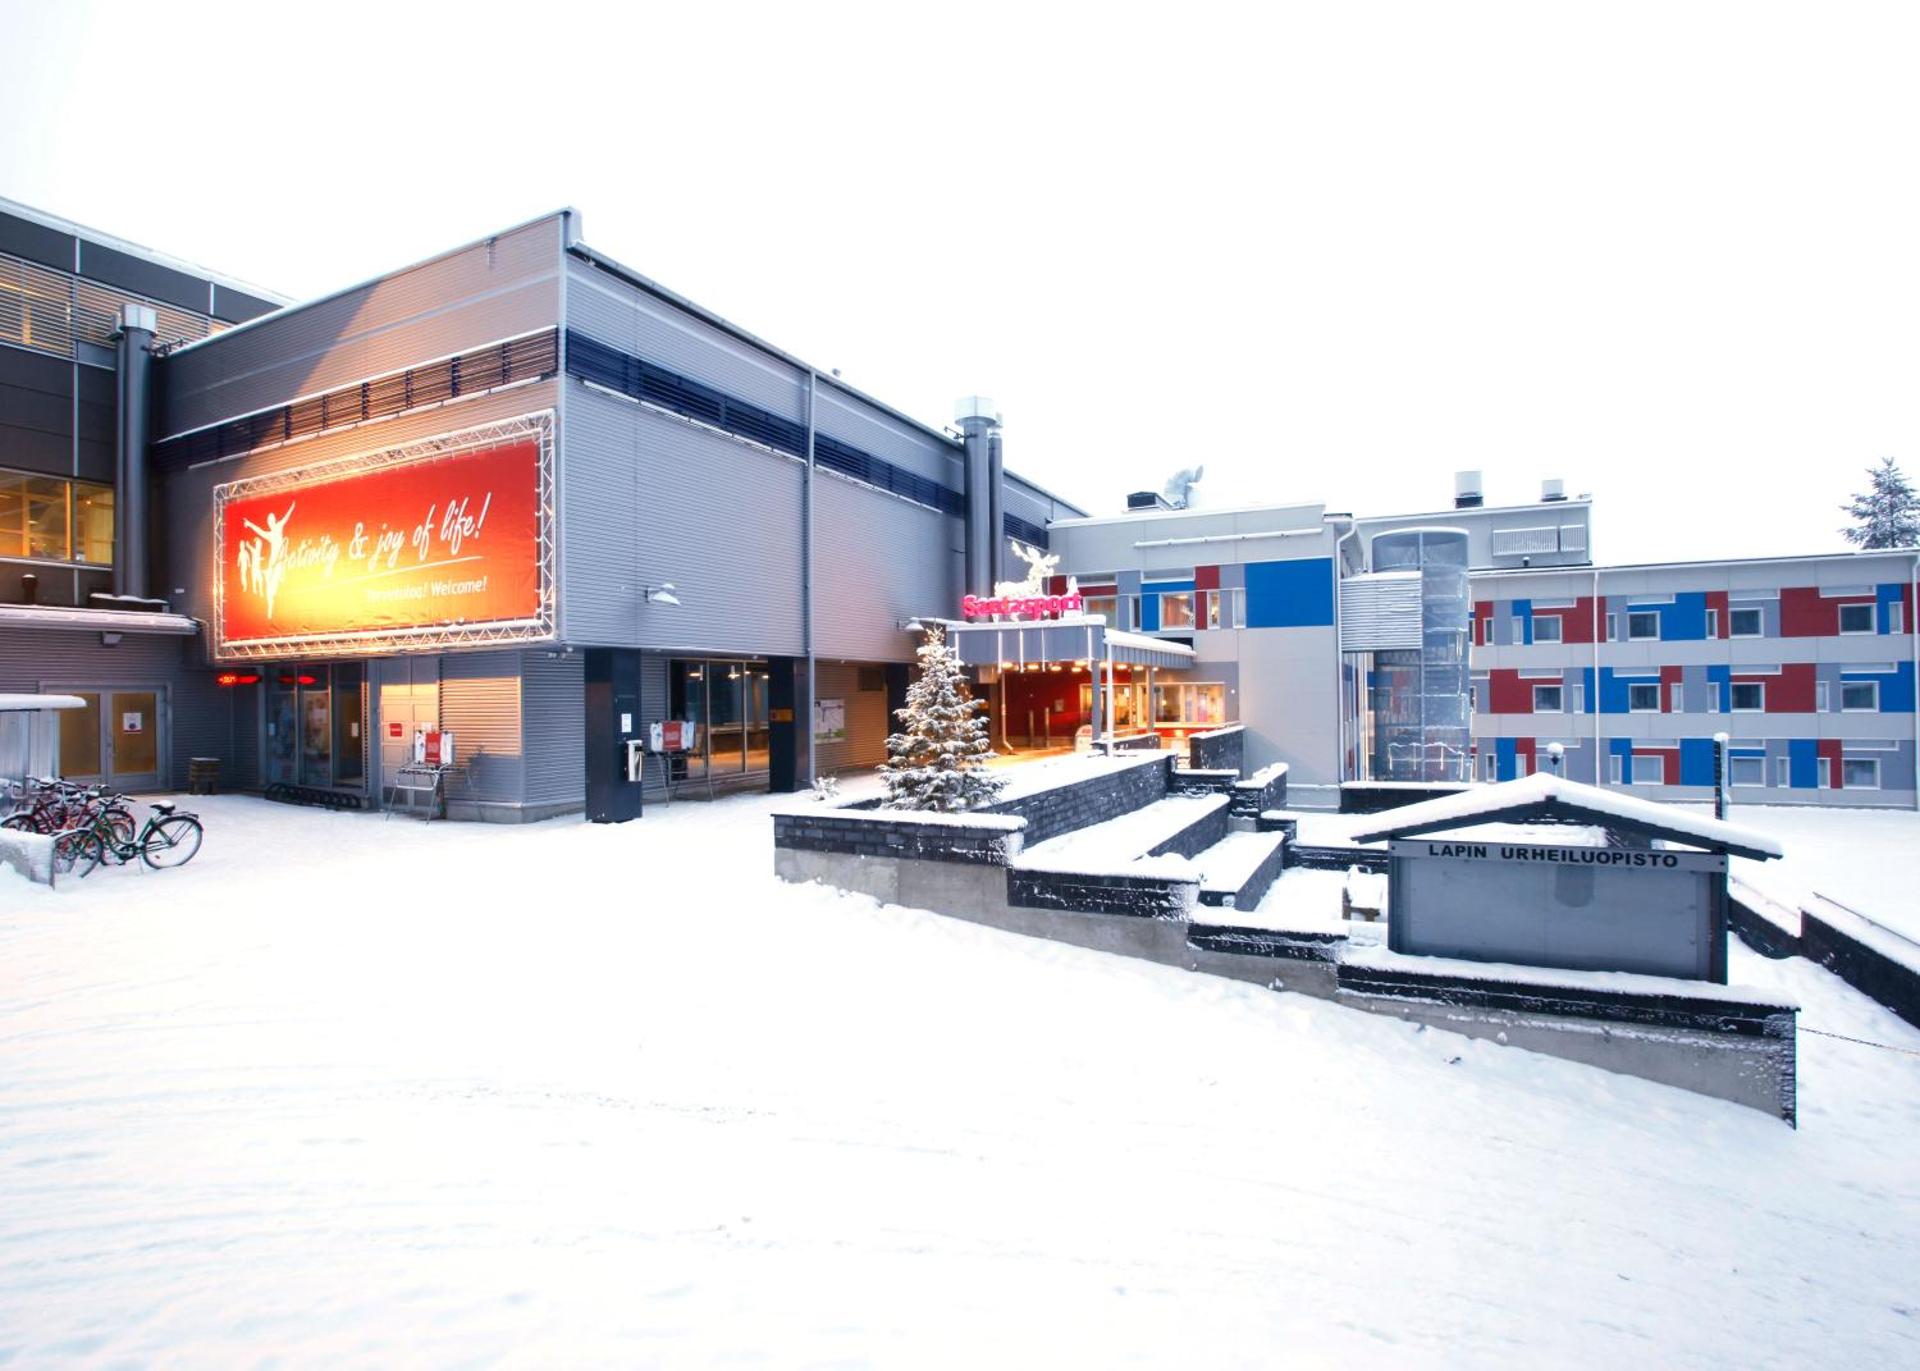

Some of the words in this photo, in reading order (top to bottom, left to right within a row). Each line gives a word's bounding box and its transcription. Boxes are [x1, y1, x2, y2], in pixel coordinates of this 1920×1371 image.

[349, 522, 369, 560] &
[369, 523, 405, 572] joy
[412, 504, 435, 561] of
[440, 491, 491, 555] life!
[432, 576, 487, 597] Welcome!
[1429, 844, 1487, 858] LAPIN
[1501, 847, 1678, 868] URHEILUOPISTO
